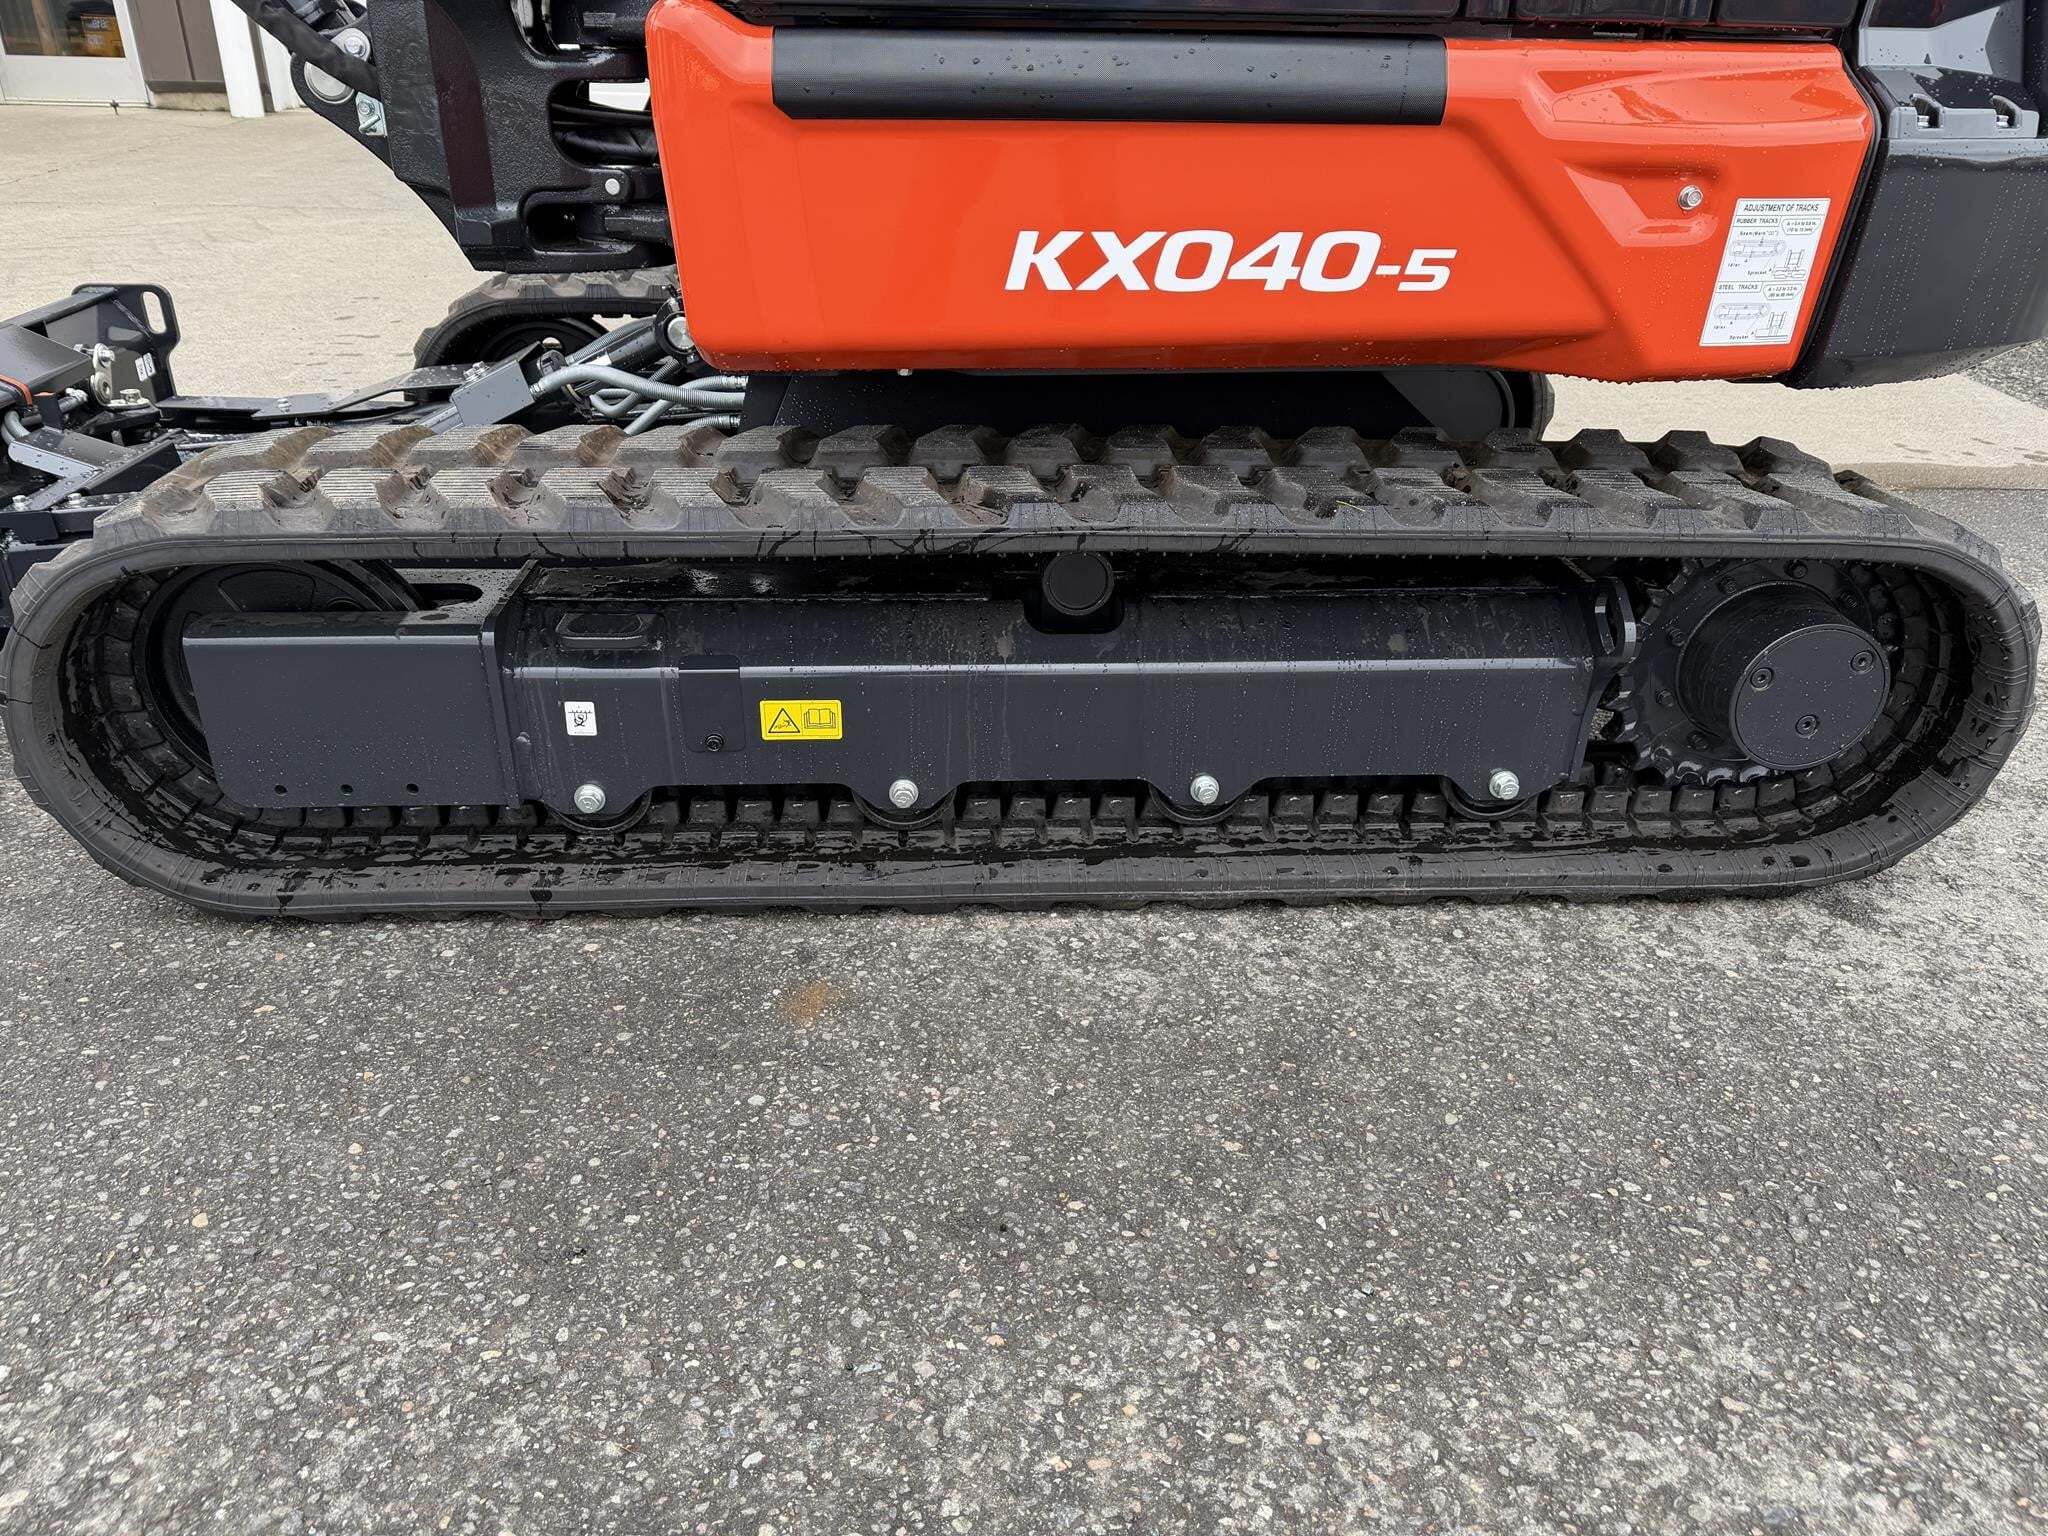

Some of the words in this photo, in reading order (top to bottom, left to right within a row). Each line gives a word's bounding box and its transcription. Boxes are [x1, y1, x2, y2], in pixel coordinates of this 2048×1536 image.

[1743, 203, 1785, 212] ADJUSTMENT
[1786, 203, 1795, 212] OF
[1795, 203, 1820, 212] TRACKS
[1004, 230, 1458, 292] KX040-5
